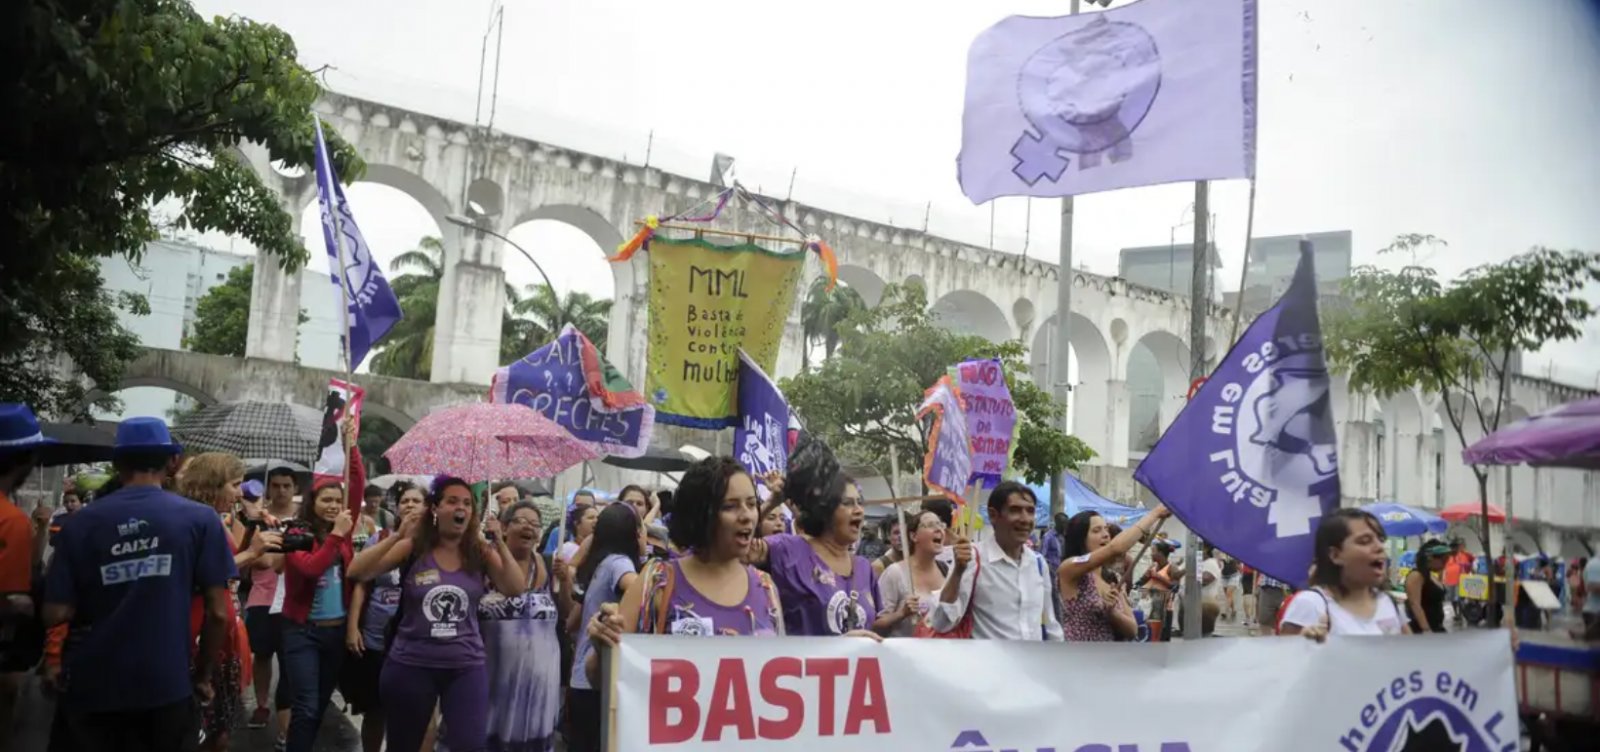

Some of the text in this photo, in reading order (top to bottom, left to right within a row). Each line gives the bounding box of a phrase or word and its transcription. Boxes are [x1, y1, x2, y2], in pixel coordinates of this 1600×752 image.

[689, 265, 748, 298] MML
[687, 304, 730, 323] Basta
[111, 536, 158, 555] CAIXA
[104, 556, 169, 581] STAFF
[648, 657, 892, 745] BASTA
[1436, 671, 1478, 711] em
